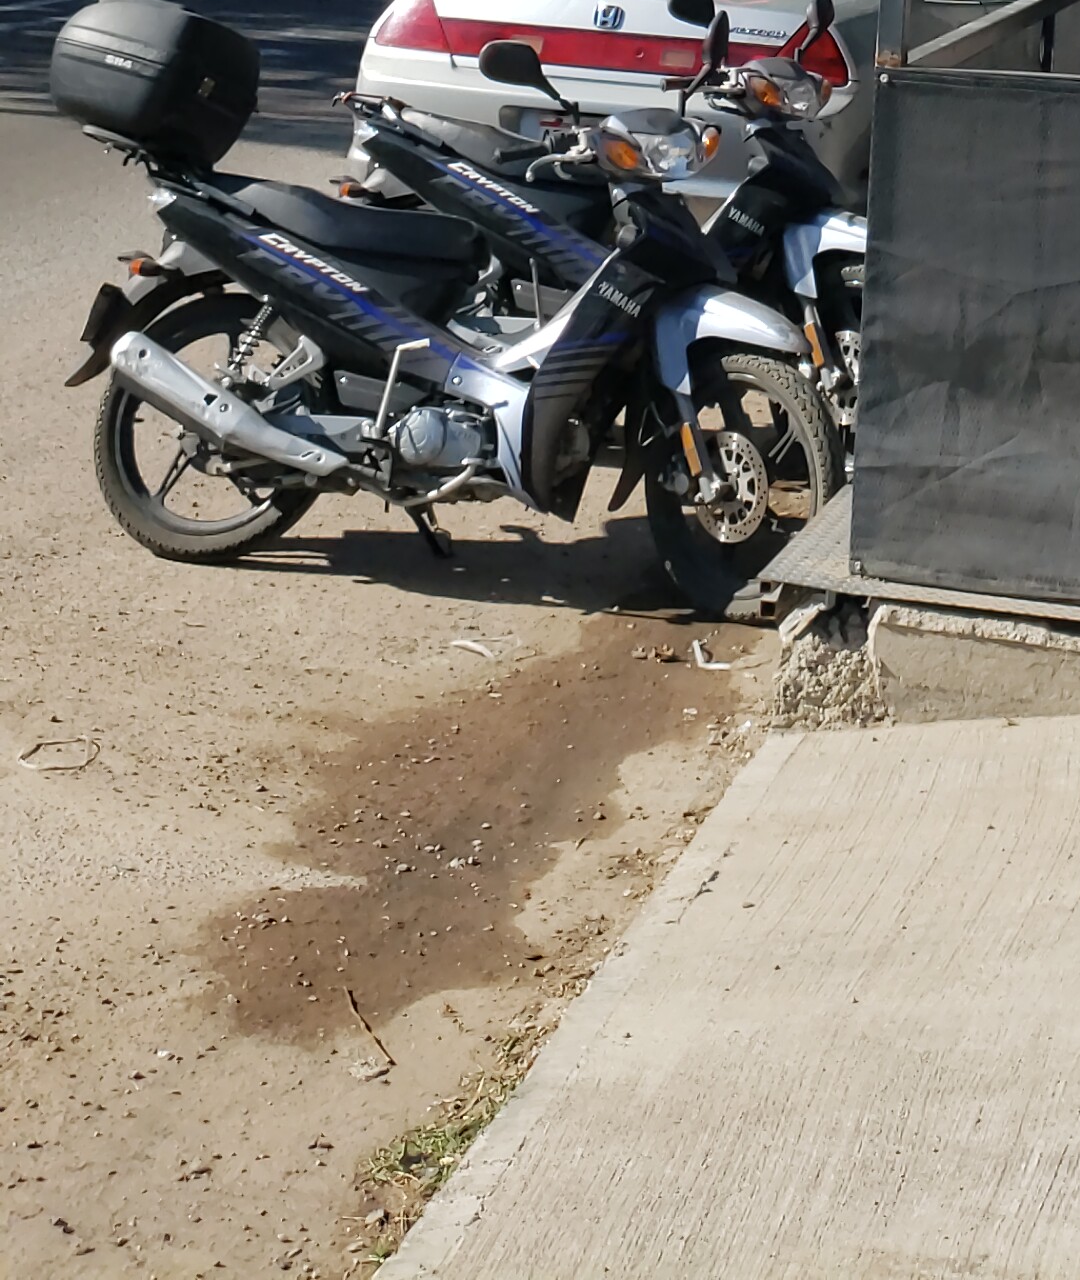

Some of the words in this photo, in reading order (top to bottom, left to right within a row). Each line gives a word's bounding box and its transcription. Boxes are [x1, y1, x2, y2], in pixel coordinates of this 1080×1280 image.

[447, 161, 541, 214] CRYPTON
[728, 206, 766, 237] YAMAHA
[257, 231, 370, 294] CRYPTON
[598, 280, 642, 319] YAMAHA
